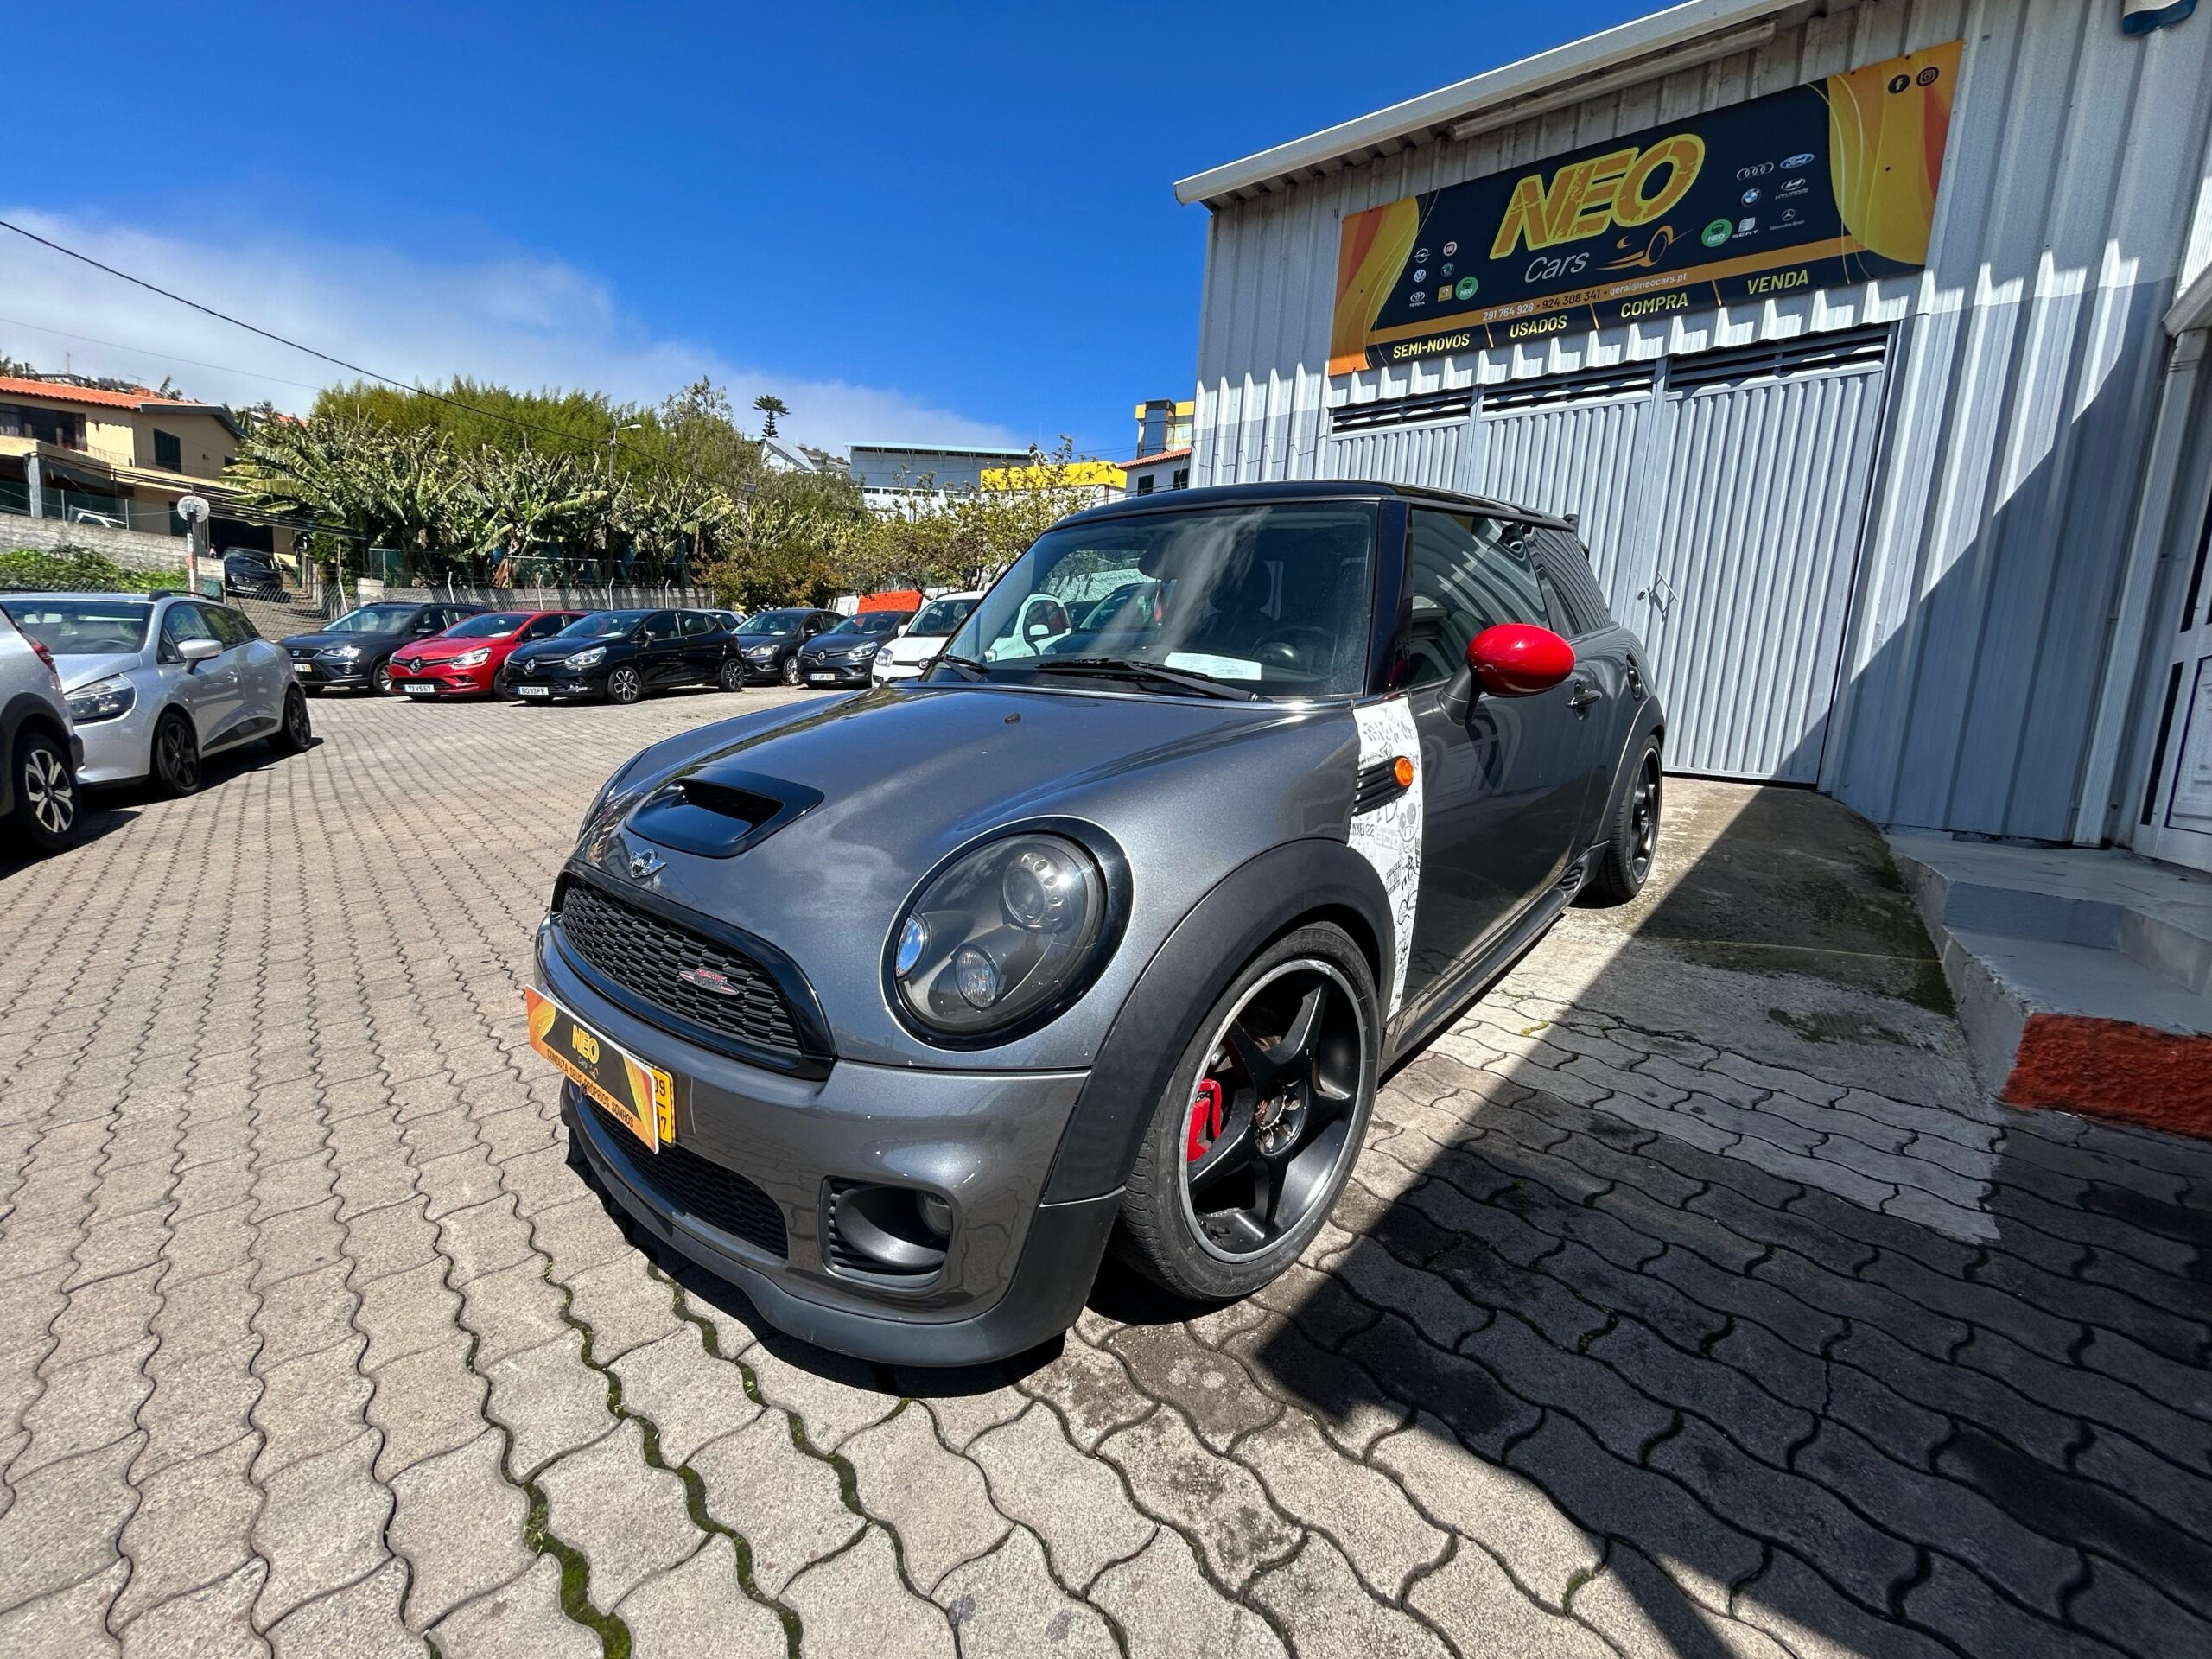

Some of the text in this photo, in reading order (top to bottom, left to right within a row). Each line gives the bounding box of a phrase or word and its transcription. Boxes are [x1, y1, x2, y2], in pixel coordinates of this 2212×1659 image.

[1489, 133, 1706, 260] NEO
[1707, 232, 1725, 243] NEO
[1732, 229, 1759, 238] SEAT
[1524, 251, 1590, 283] Cars
[1483, 272, 1688, 321] 291 764 928 924 308 341 geral@neocars.pt
[1747, 269, 1809, 296] VENDA
[1620, 291, 1688, 319] COMPRA
[1510, 315, 1567, 338] USADOS
[1393, 333, 1471, 359] SEMI-NOVOS
[572, 1024, 600, 1065] NEO
[547, 1048, 569, 1073] CONDUZA
[611, 1101, 634, 1128] SONHOS
